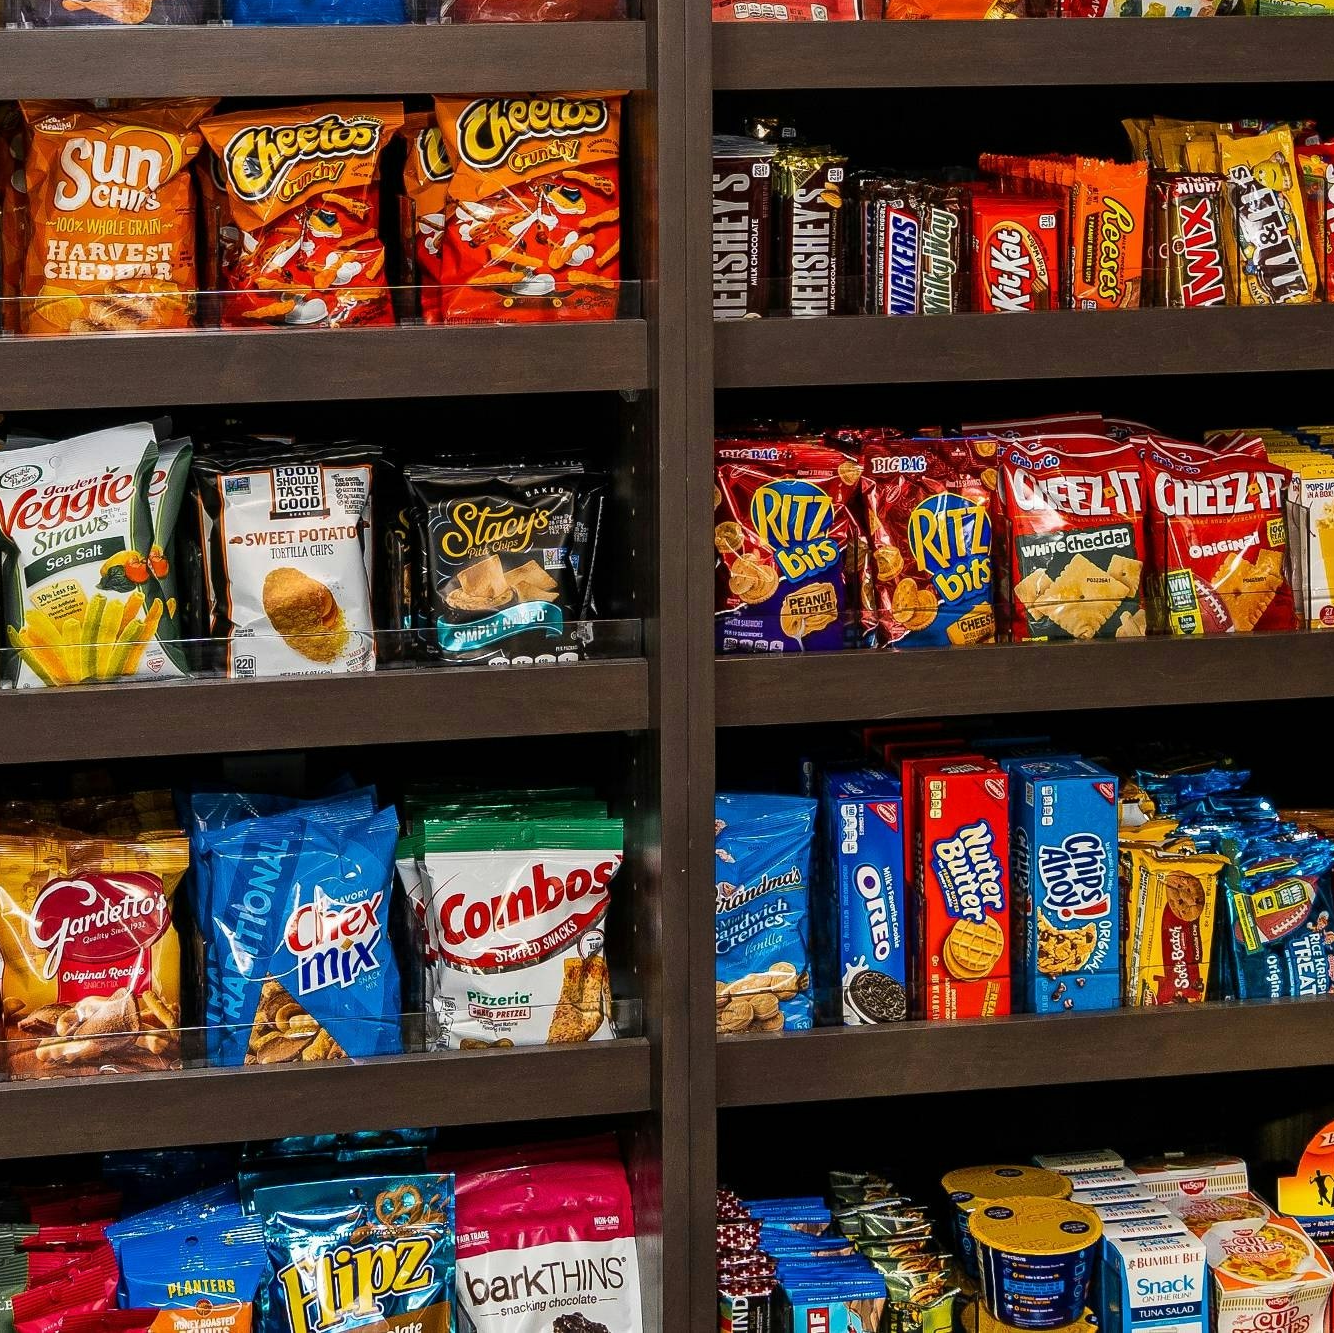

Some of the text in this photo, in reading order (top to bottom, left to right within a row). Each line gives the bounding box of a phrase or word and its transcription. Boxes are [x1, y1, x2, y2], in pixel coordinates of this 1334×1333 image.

[461, 97, 605, 165] Cheetos
[228, 116, 378, 199] Cheetos
[508, 139, 580, 174] Crunchy
[54, 137, 163, 211] Sun
[278, 161, 344, 202] Crunchy
[86, 219, 161, 236] WHOLE GRAIN
[46, 239, 173, 262] HARVEST
[751, 218, 759, 286] MILK CHOCOLATE
[1099, 197, 1134, 302] Reese's
[1180, 198, 1225, 307] TWIX
[44, 260, 173, 281] CHEDDAR
[276, 466, 317, 476] FOOD
[872, 456, 926, 474] BIG BAG
[1044, 454, 1059, 467] Go
[41, 476, 97, 499] garden
[276, 476, 318, 487] SHOULD
[277, 486, 319, 497] TASTE
[525, 487, 564, 498] BAKED
[1306, 482, 1324, 492] POPS
[278, 496, 321, 510] GOOD
[755, 487, 833, 547] RITZ
[32, 514, 109, 557] Straws
[245, 526, 357, 546] SWEET POTATO
[442, 502, 550, 557] Stacy's
[911, 505, 988, 571] RITZ
[1068, 529, 1129, 552] cheddar
[46, 544, 103, 572] Sea Salt
[270, 544, 334, 559] TORTILLA CHIPS
[468, 539, 519, 559] Pita Chips
[777, 540, 838, 578] bits
[934, 558, 990, 602] bits
[789, 591, 831, 608] PEANUT
[454, 621, 499, 644] SIMPLY
[236, 658, 254, 669] 220
[960, 823, 1003, 910] Nutter
[1063, 837, 1102, 903] Chips
[936, 840, 983, 922] Butter
[440, 862, 613, 945] Combos
[855, 865, 891, 961] OREO
[29, 880, 167, 980] Gardetto's
[287, 891, 383, 952] Chex
[543, 920, 578, 949] SNACKS
[1171, 924, 1183, 959] Batch
[1309, 933, 1322, 956] RICE
[62, 969, 107, 984] Original
[365, 981, 379, 992] MIX
[467, 991, 531, 1006] Pizzeria
[496, 1009, 527, 1018] PRETZEL
[1181, 1181, 1205, 1191] NISSIN
[470, 1230, 490, 1243] TRADE
[1232, 1235, 1267, 1247] CUP
[1137, 1254, 1181, 1269] BUMBLE
[168, 1279, 235, 1299] PLANTERS
[464, 1257, 624, 1308] barkTHINS
[1137, 1275, 1195, 1296] Snack
[500, 1294, 598, 1317] snacking chocolate
[1142, 1291, 1192, 1304] ON THE RUN!
[201, 1317, 236, 1329] ROASTED
[1139, 1306, 1195, 1318] TUNA SALAD
[1254, 1306, 1299, 1330] CUP
